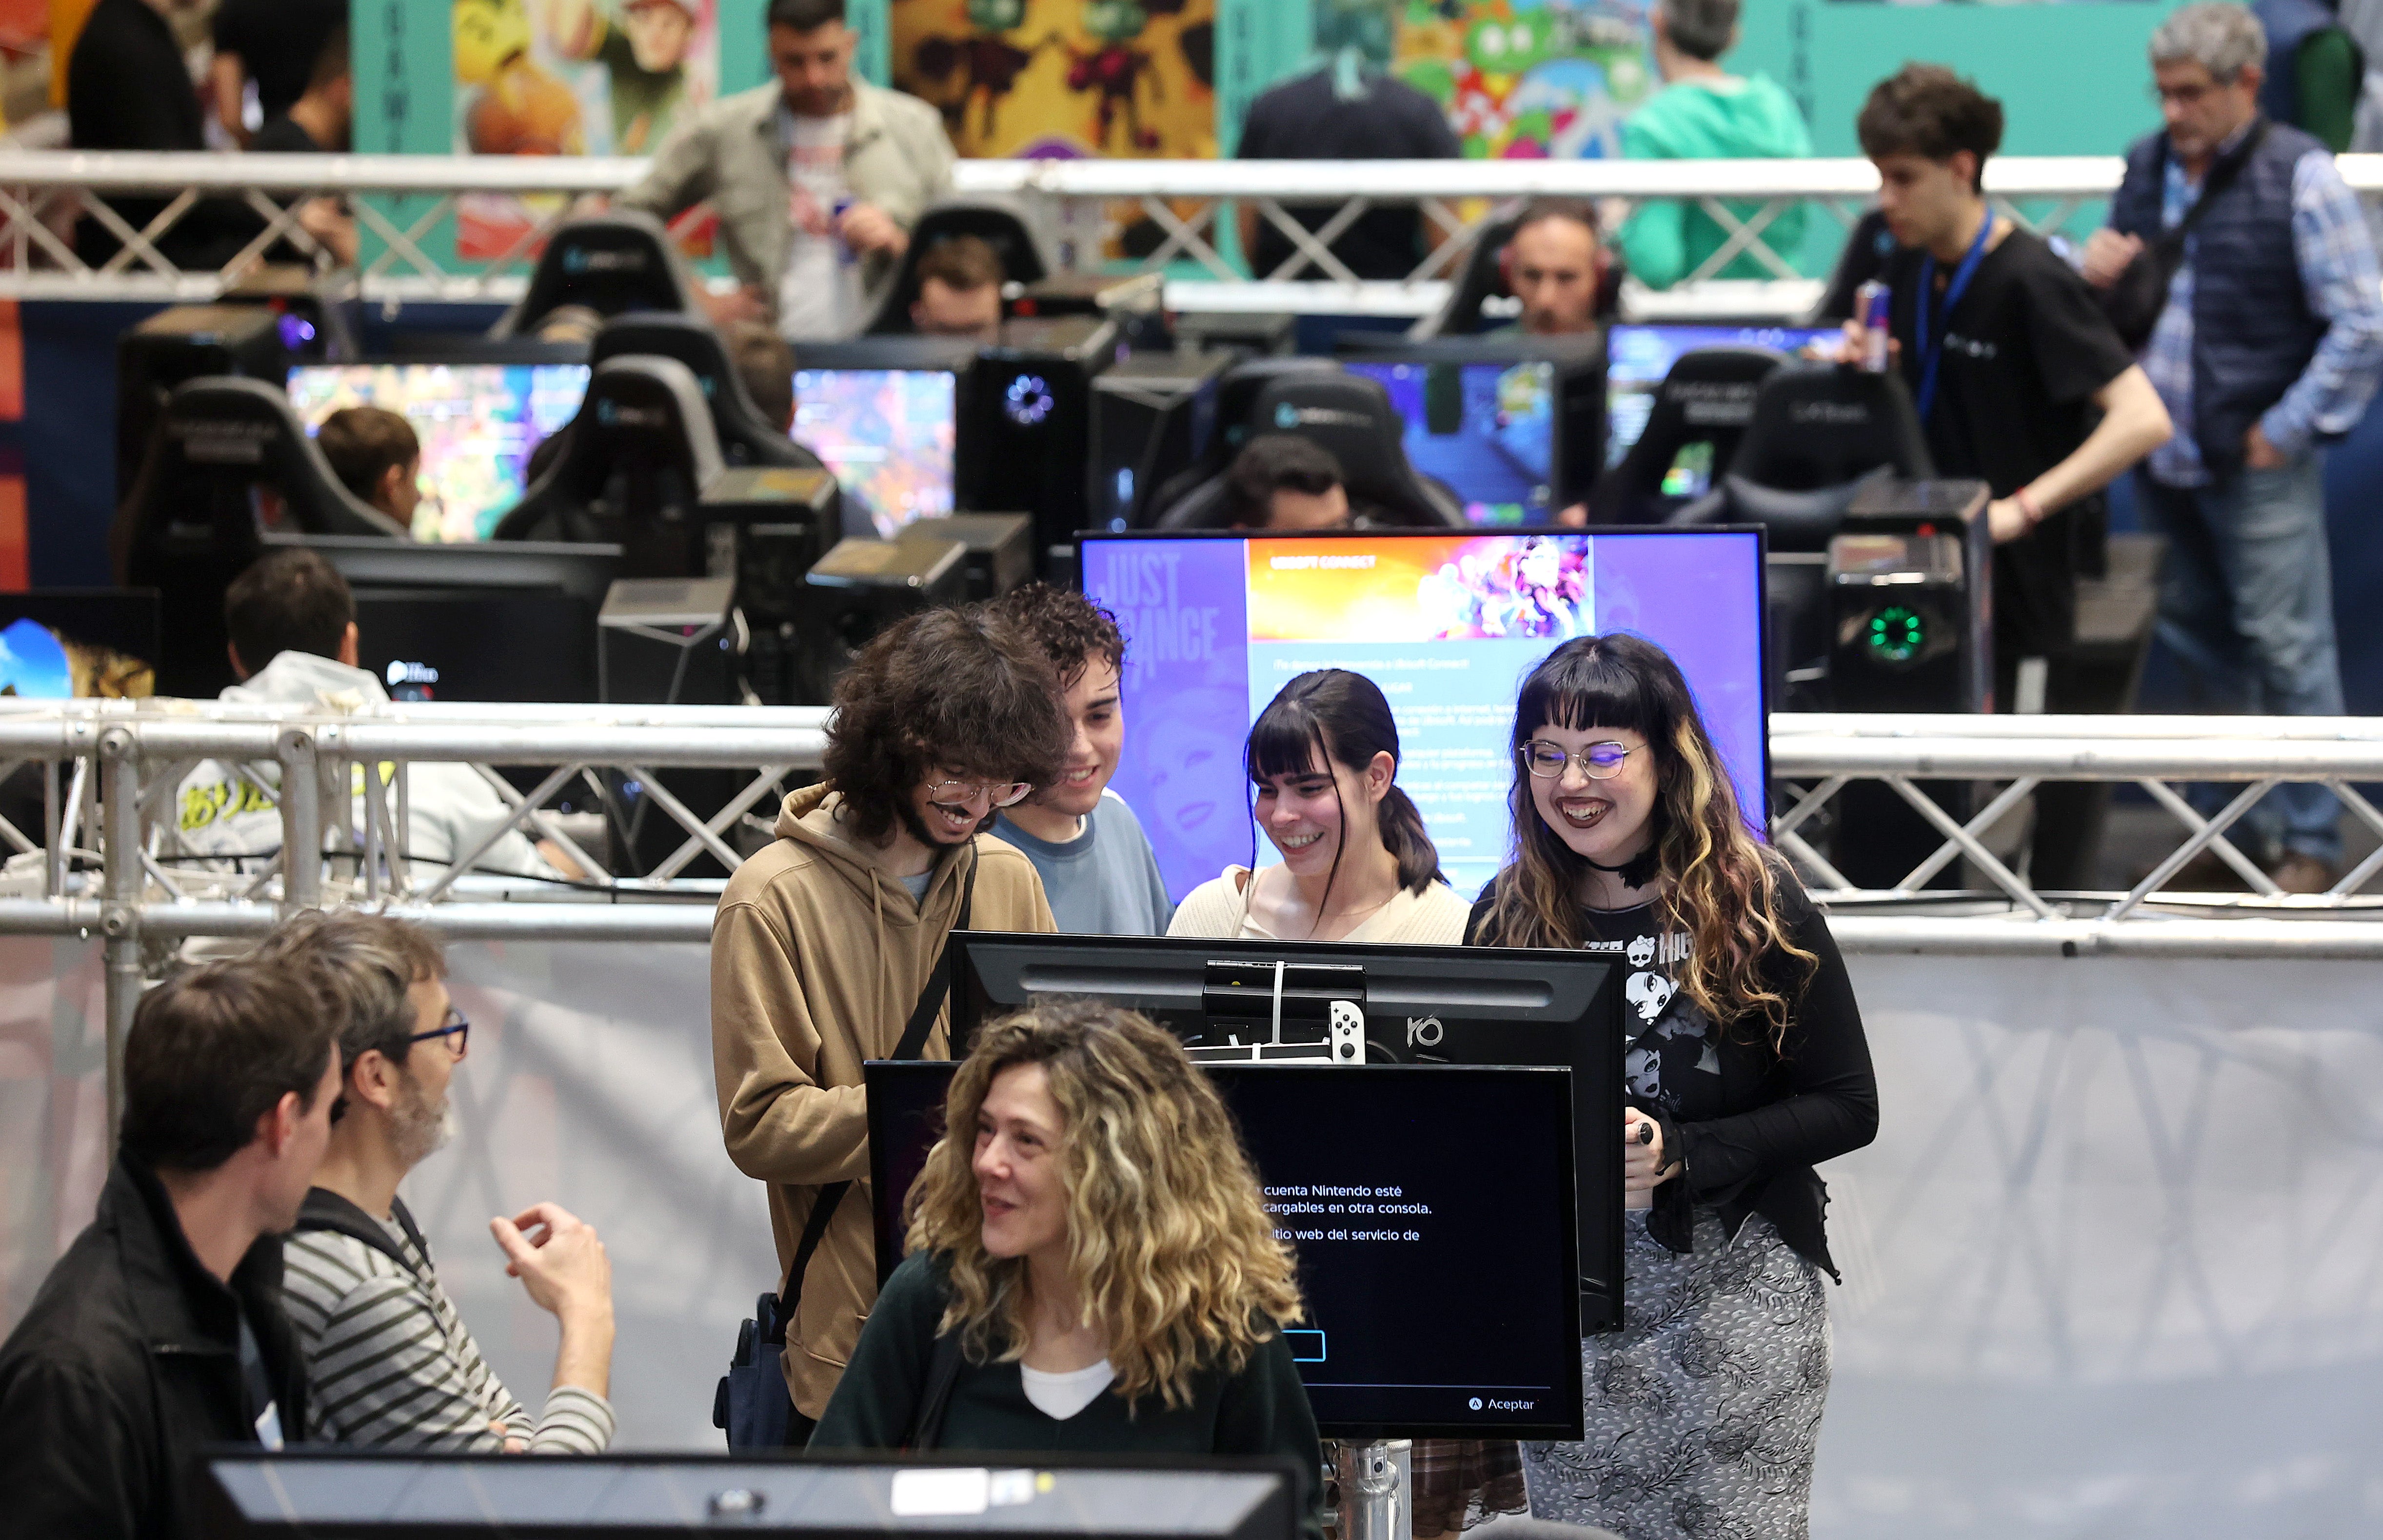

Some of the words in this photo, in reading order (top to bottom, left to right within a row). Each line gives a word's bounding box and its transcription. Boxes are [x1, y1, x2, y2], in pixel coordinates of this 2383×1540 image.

[1098, 552, 1181, 608] JUST
[1264, 1185, 1308, 1196] cuenta
[1312, 1185, 1371, 1196] Nintendo
[1375, 1186, 1402, 1197] esté
[1329, 1204, 1344, 1214] en
[1348, 1203, 1374, 1214] otra
[1378, 1203, 1432, 1214] consola.
[1271, 1228, 1292, 1240] itio
[1295, 1229, 1324, 1240] web
[1328, 1229, 1348, 1241] del
[1352, 1229, 1400, 1241] servicio
[1403, 1229, 1420, 1241] de
[1488, 1398, 1534, 1412] Aceptar
